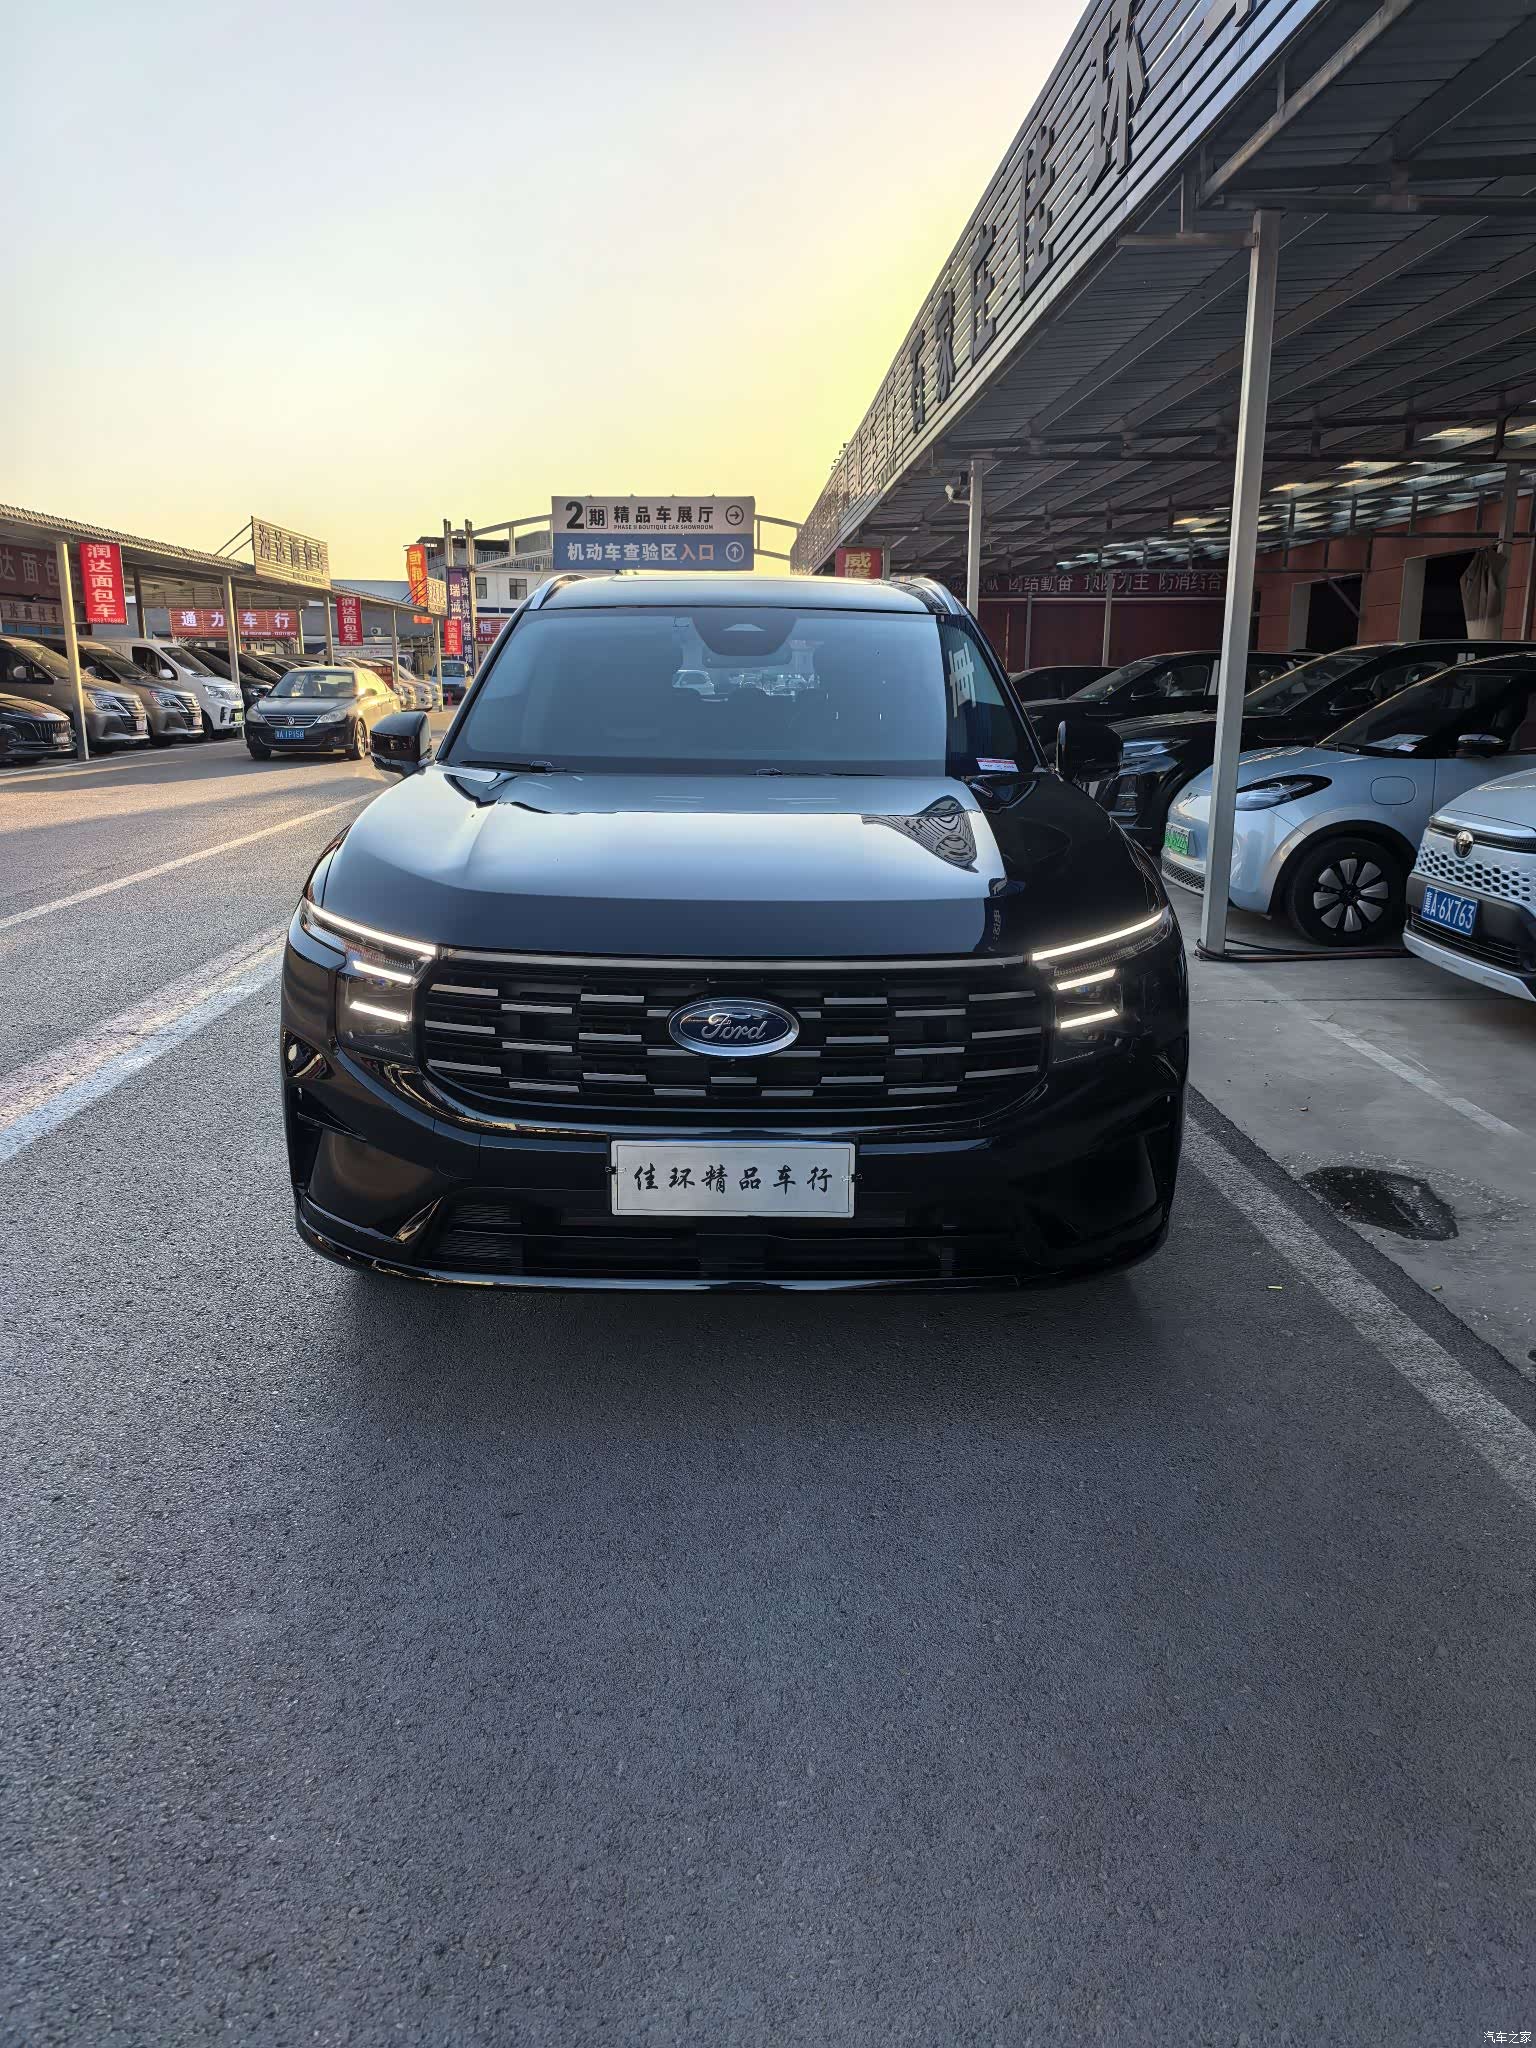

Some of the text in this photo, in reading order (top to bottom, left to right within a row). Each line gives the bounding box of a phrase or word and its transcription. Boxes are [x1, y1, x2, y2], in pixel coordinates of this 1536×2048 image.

[565, 501, 714, 530] 2期 精品车展厅
[567, 542, 715, 562] 机动车查验区入口
[87, 544, 116, 618] 润达面包车
[181, 611, 290, 628] 通力车行
[341, 598, 358, 641] 润达面包车
[700, 1012, 768, 1041] Ford
[633, 1163, 833, 1195] 佳环精品车行
